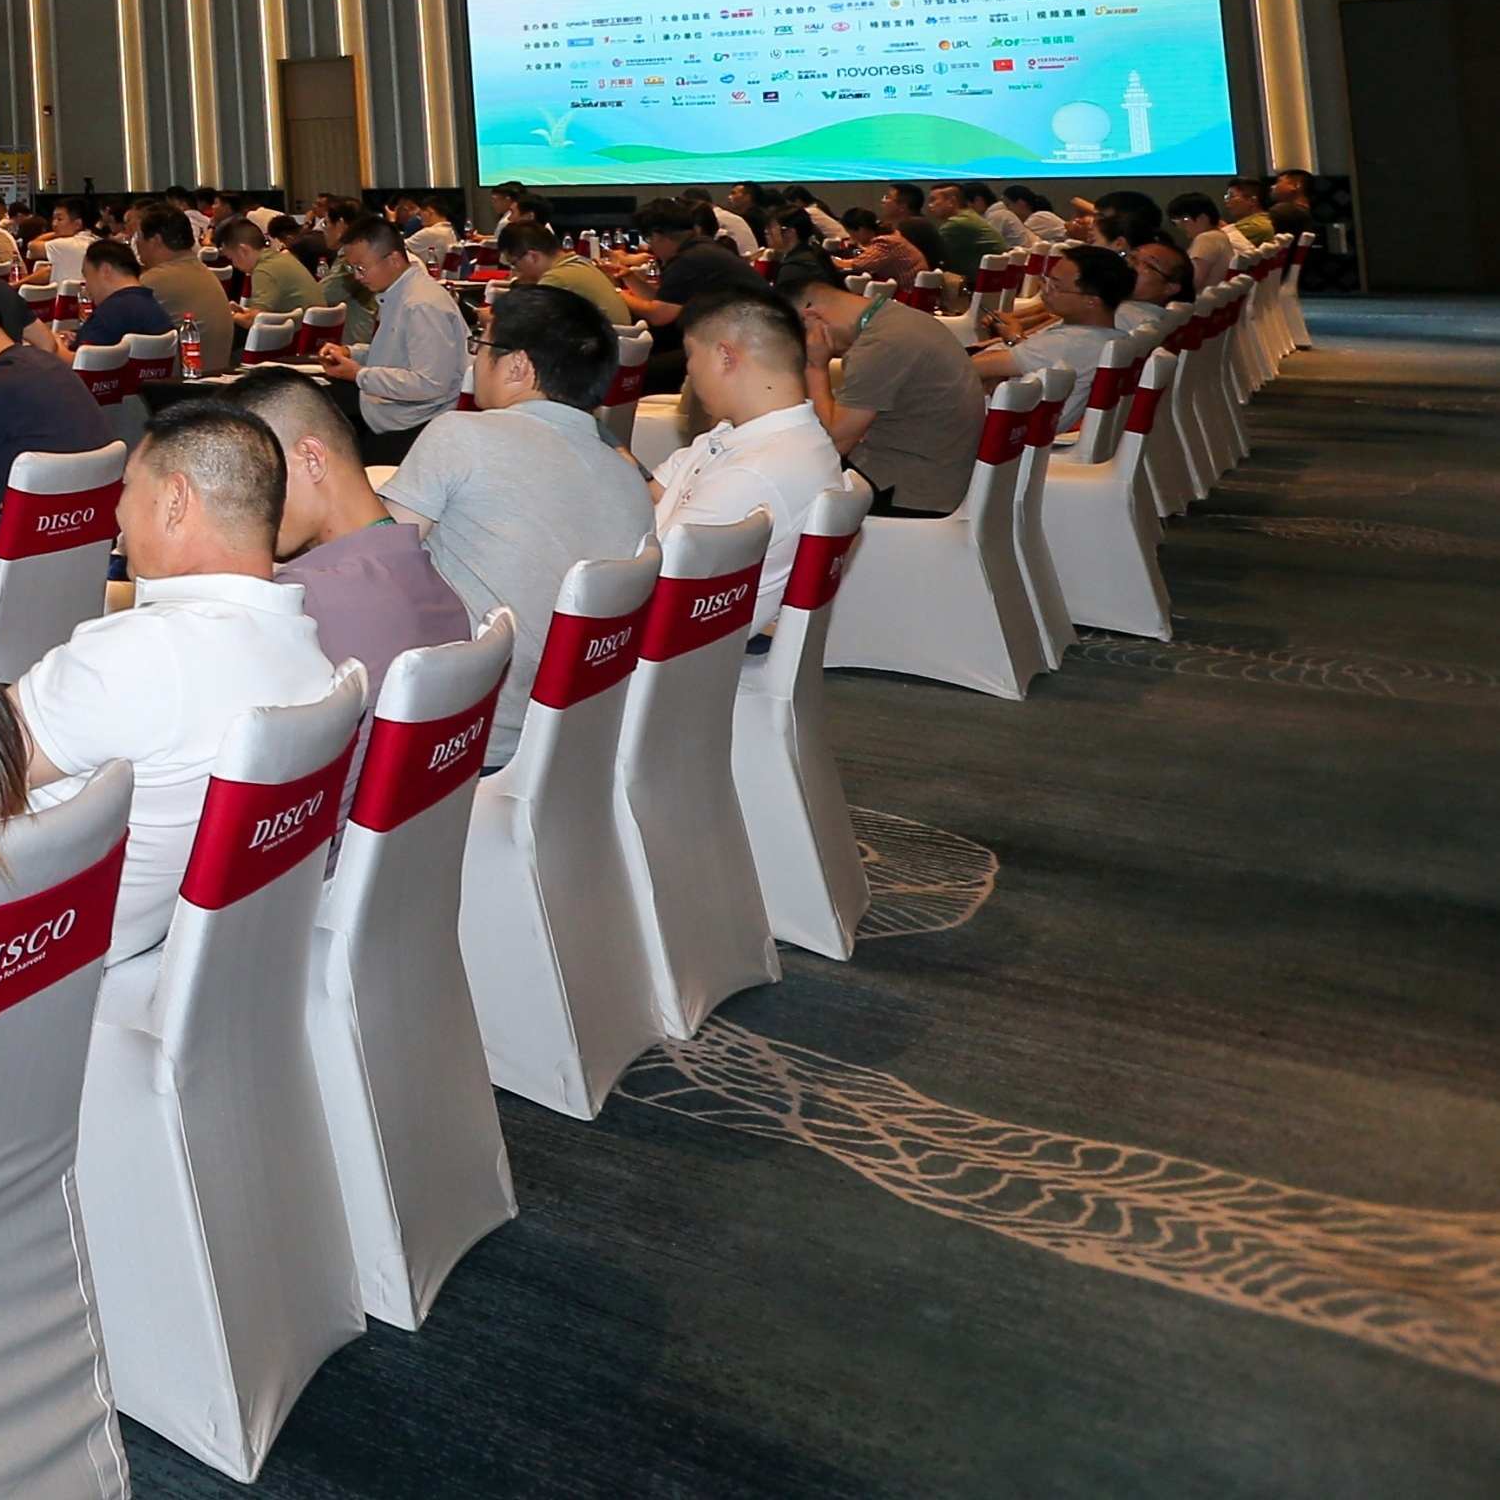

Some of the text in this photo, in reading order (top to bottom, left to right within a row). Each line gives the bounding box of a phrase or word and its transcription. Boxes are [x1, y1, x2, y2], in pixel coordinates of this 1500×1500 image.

[837, 63, 924, 78] novonesis
[36, 507, 95, 532] DISCO
[690, 583, 749, 619] DISCO
[584, 626, 633, 662] DISCO
[428, 716, 485, 770] DISCO
[248, 790, 325, 850] DISCO
